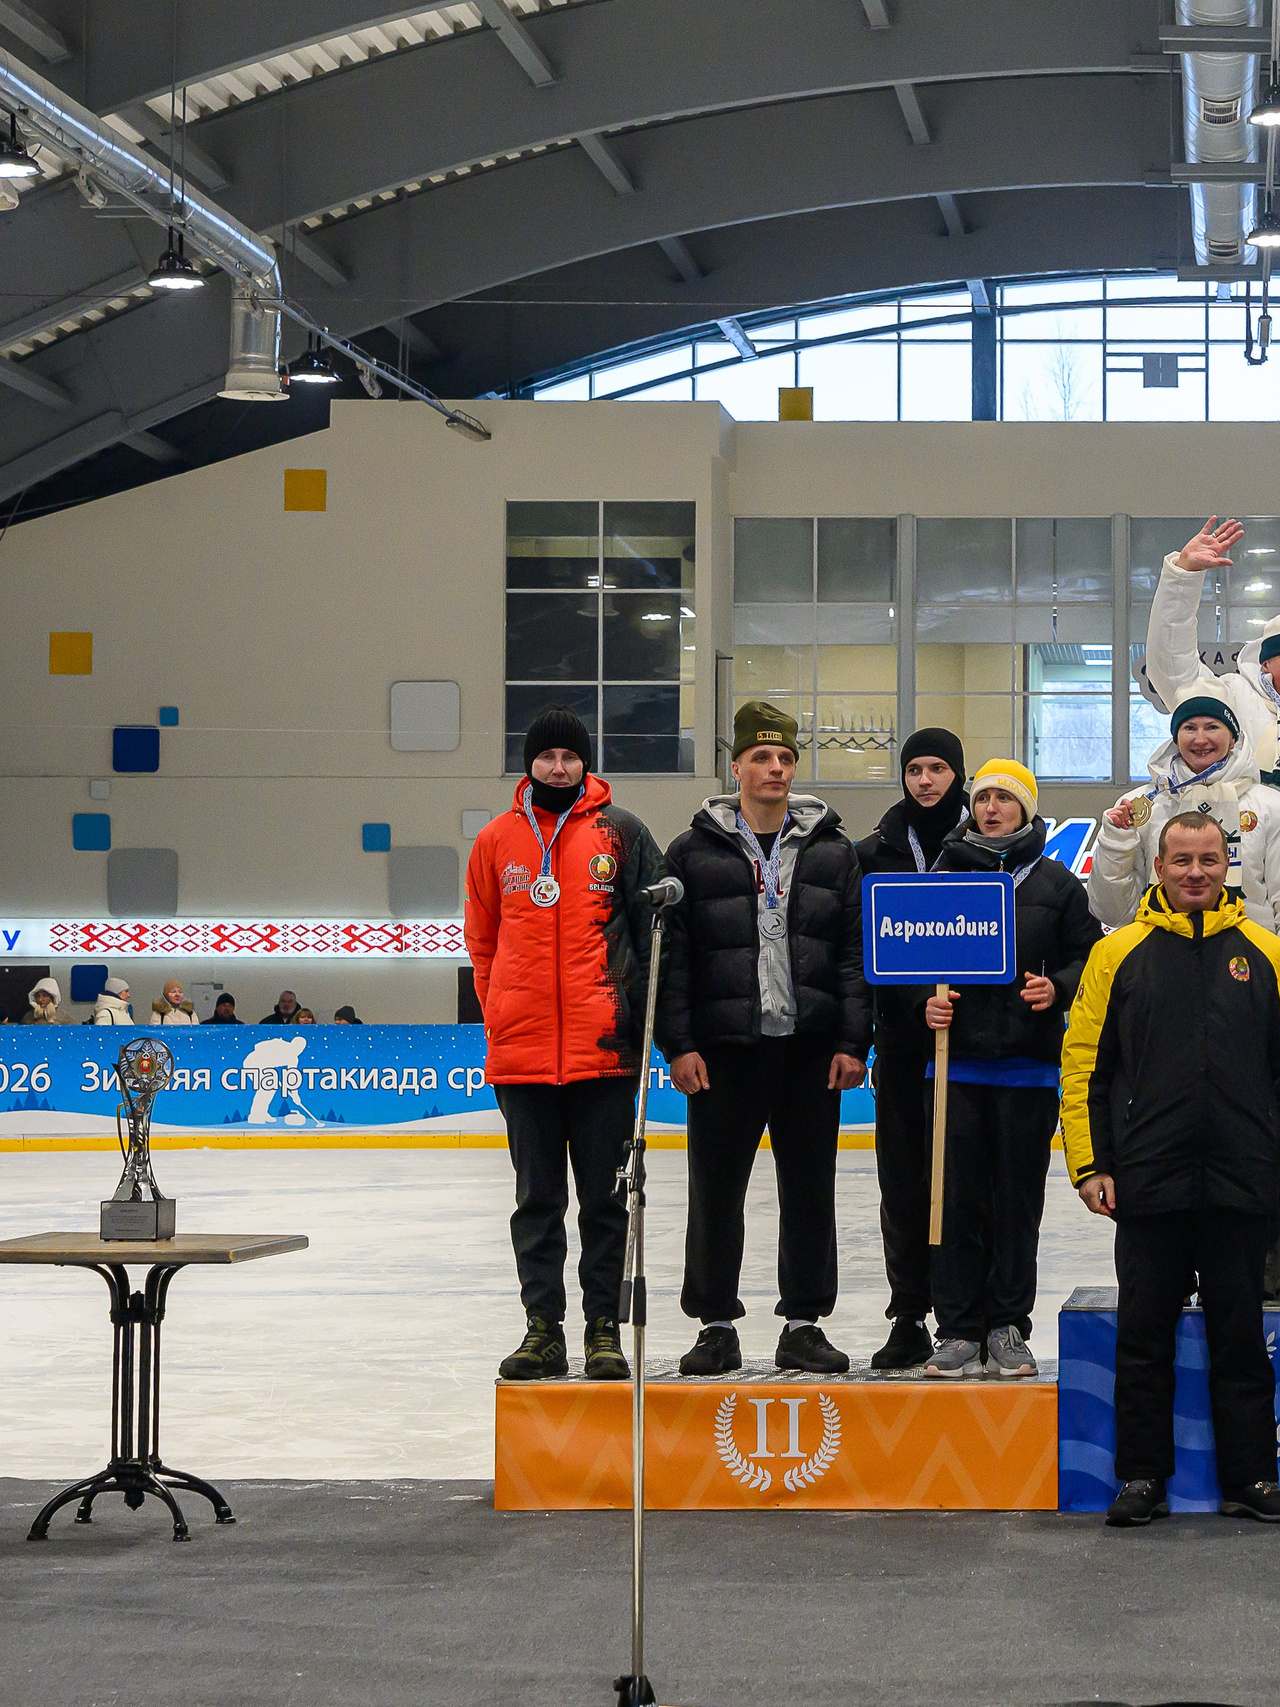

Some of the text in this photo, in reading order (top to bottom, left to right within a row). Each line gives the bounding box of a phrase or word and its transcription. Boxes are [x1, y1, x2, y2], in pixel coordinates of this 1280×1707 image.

[880, 914, 999, 943] Агрохолдинг
[80, 1061, 211, 1093] Зияя
[220, 1067, 438, 1098] спартакиада
[748, 1398, 808, 1458] II
